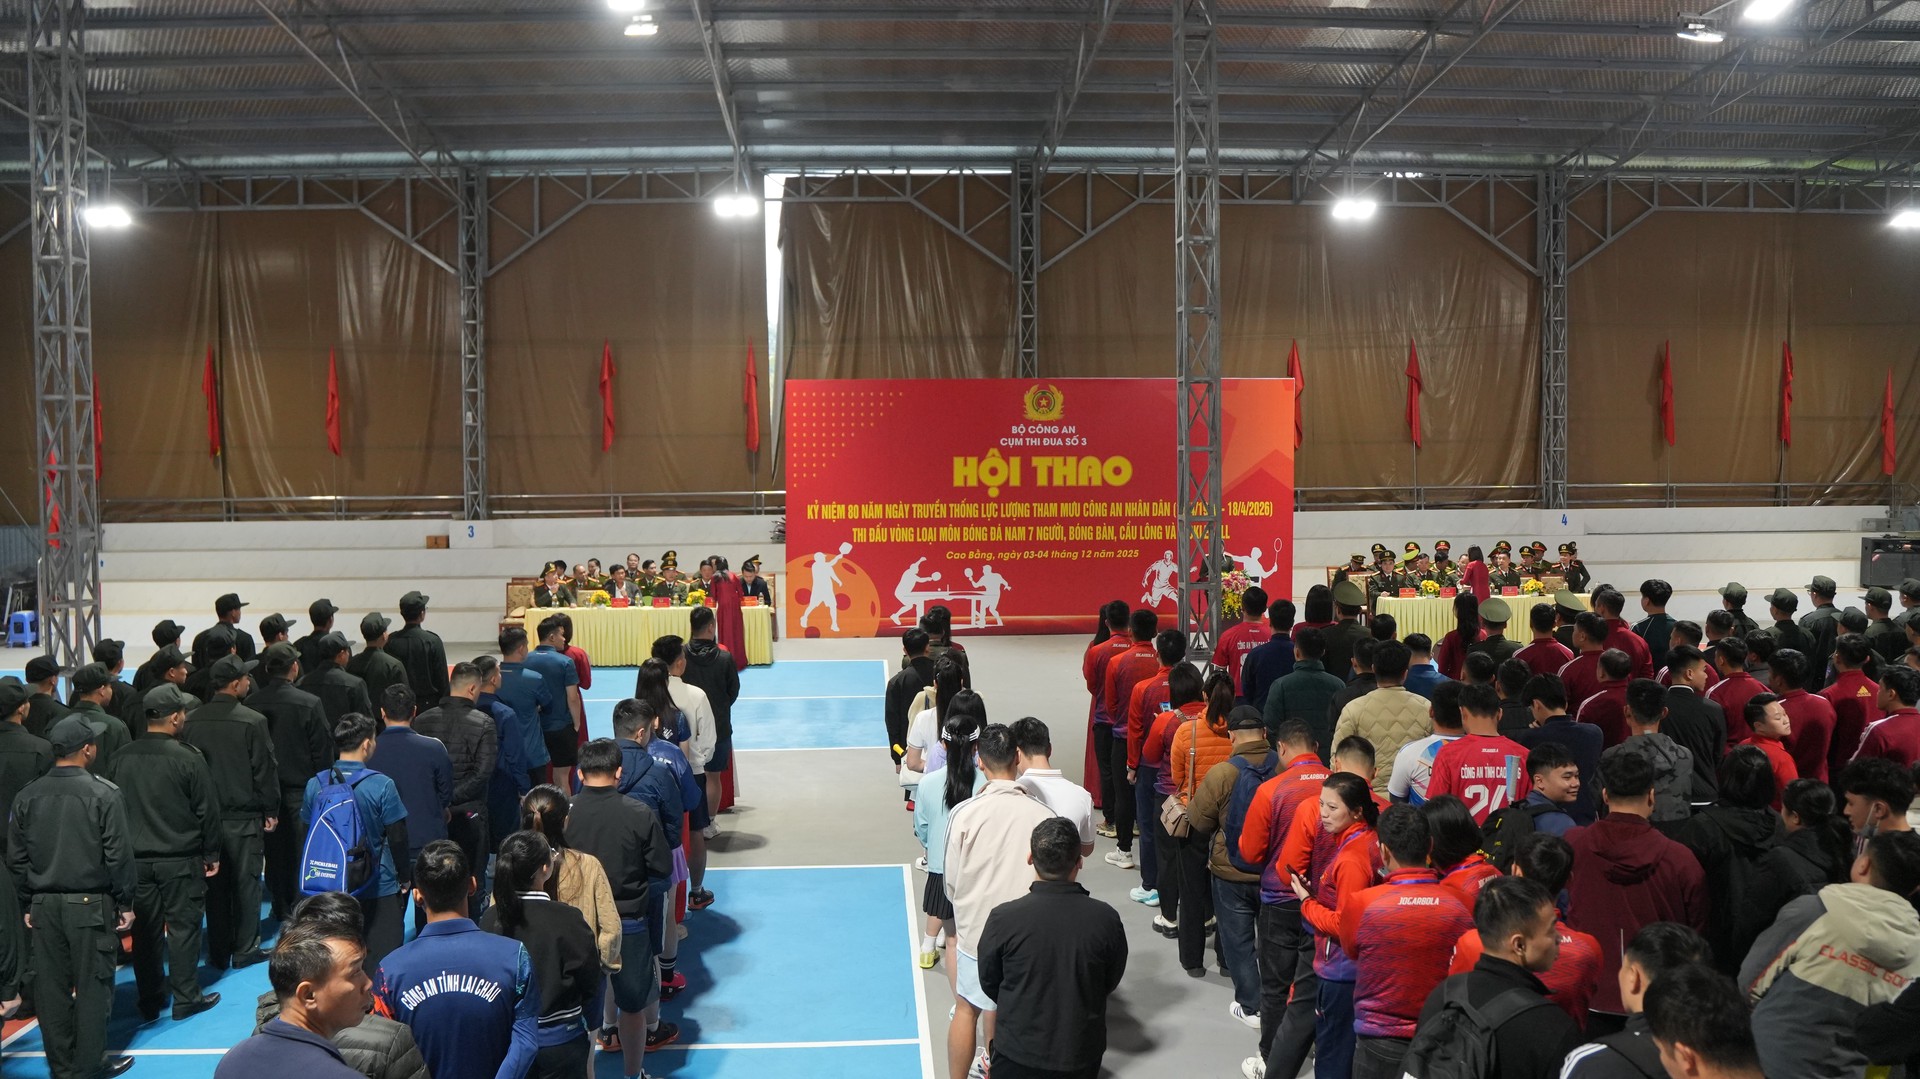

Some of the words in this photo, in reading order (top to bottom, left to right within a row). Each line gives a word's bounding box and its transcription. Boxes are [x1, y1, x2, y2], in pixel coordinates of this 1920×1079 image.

[1012, 424, 1026, 436] BỘ
[1028, 424, 1060, 434] CÔNG
[1062, 426, 1076, 434] AN
[1000, 438, 1023, 448] CỤM
[1026, 438, 1040, 446] THI
[1042, 438, 1063, 446] ĐUA
[1066, 434, 1079, 446] SỐ
[1082, 438, 1087, 446] 3
[952, 448, 1022, 498] HỘI
[1031, 455, 1133, 487] THAO
[808, 500, 819, 520] KỶ
[822, 501, 846, 522] NIỆM
[848, 504, 859, 520] 80
[862, 501, 883, 519] NĂM
[886, 501, 910, 518] NGÀY
[949, 498, 979, 518] THỐNG
[981, 502, 998, 521] LỰC
[1001, 502, 1030, 521] LƯỢNG
[1033, 502, 1058, 518] THAM
[1060, 501, 1080, 518] MƯU
[1083, 500, 1108, 517] CÔNG
[1110, 502, 1122, 517] AN
[1125, 499, 1150, 517] NHÂN
[1152, 499, 1170, 517] DÂN
[1228, 501, 1274, 517] 18/4/2026)
[1562, 513, 1568, 526] 4
[468, 525, 474, 538] 3
[852, 528, 866, 542] THI
[869, 522, 888, 542] ĐẤU
[890, 524, 914, 542] VÒNG
[916, 527, 937, 546] LOẠI
[940, 524, 960, 542] MÔN
[963, 524, 988, 542] BÓNG
[990, 524, 1002, 541] ĐÁ
[1004, 526, 1026, 541] NAM
[1028, 526, 1034, 541] 7
[1036, 522, 1066, 542] NGƯỜI,
[1069, 523, 1094, 540] BÓNG
[1096, 522, 1116, 542] BÀN,
[1120, 520, 1138, 540] CẦU
[1140, 522, 1162, 540] LÔNG
[1165, 522, 1176, 540] VÀ
[946, 551, 966, 560] Cao
[968, 549, 995, 560] Bằng,
[998, 550, 1022, 560] ngày
[1024, 550, 1048, 559] 03-04
[1051, 550, 1078, 560] tháng
[1082, 550, 1092, 558] 12
[1094, 550, 1114, 558] năm
[1116, 550, 1140, 558] 2025
[1461, 764, 1476, 778] CÔNG
[1476, 766, 1484, 778] AN
[1485, 763, 1496, 778] TỈNH
[1398, 896, 1440, 906] JOGARBOLA
[1819, 944, 1878, 977] CLASSIC
[400, 985, 426, 1011] CÔNG
[422, 978, 438, 998] AN
[436, 970, 460, 994] TỈNH
[460, 974, 478, 994] LAI
[474, 978, 502, 1003] CHÂU
